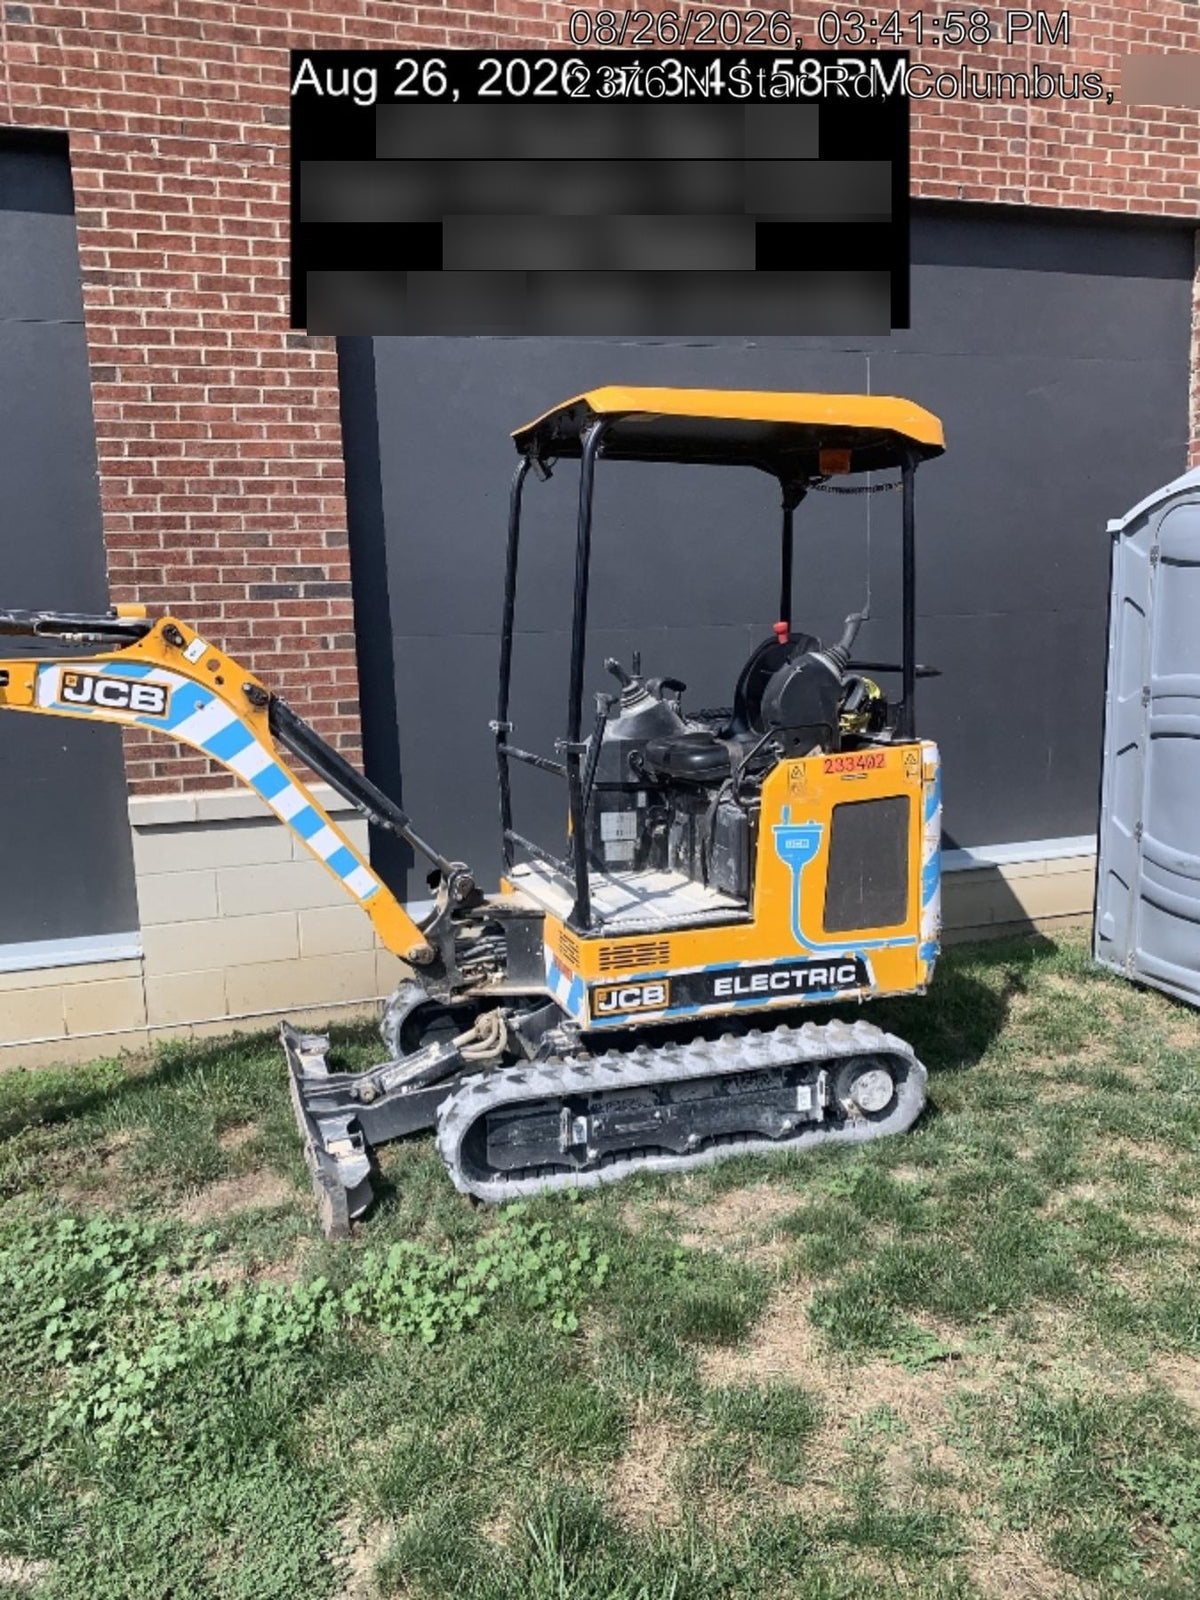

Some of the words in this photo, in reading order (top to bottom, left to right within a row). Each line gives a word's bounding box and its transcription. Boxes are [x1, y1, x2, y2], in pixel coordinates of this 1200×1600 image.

[63, 677, 165, 713] JCB
[599, 985, 665, 1011] JCB
[714, 965, 856, 996] ELECTRIC
